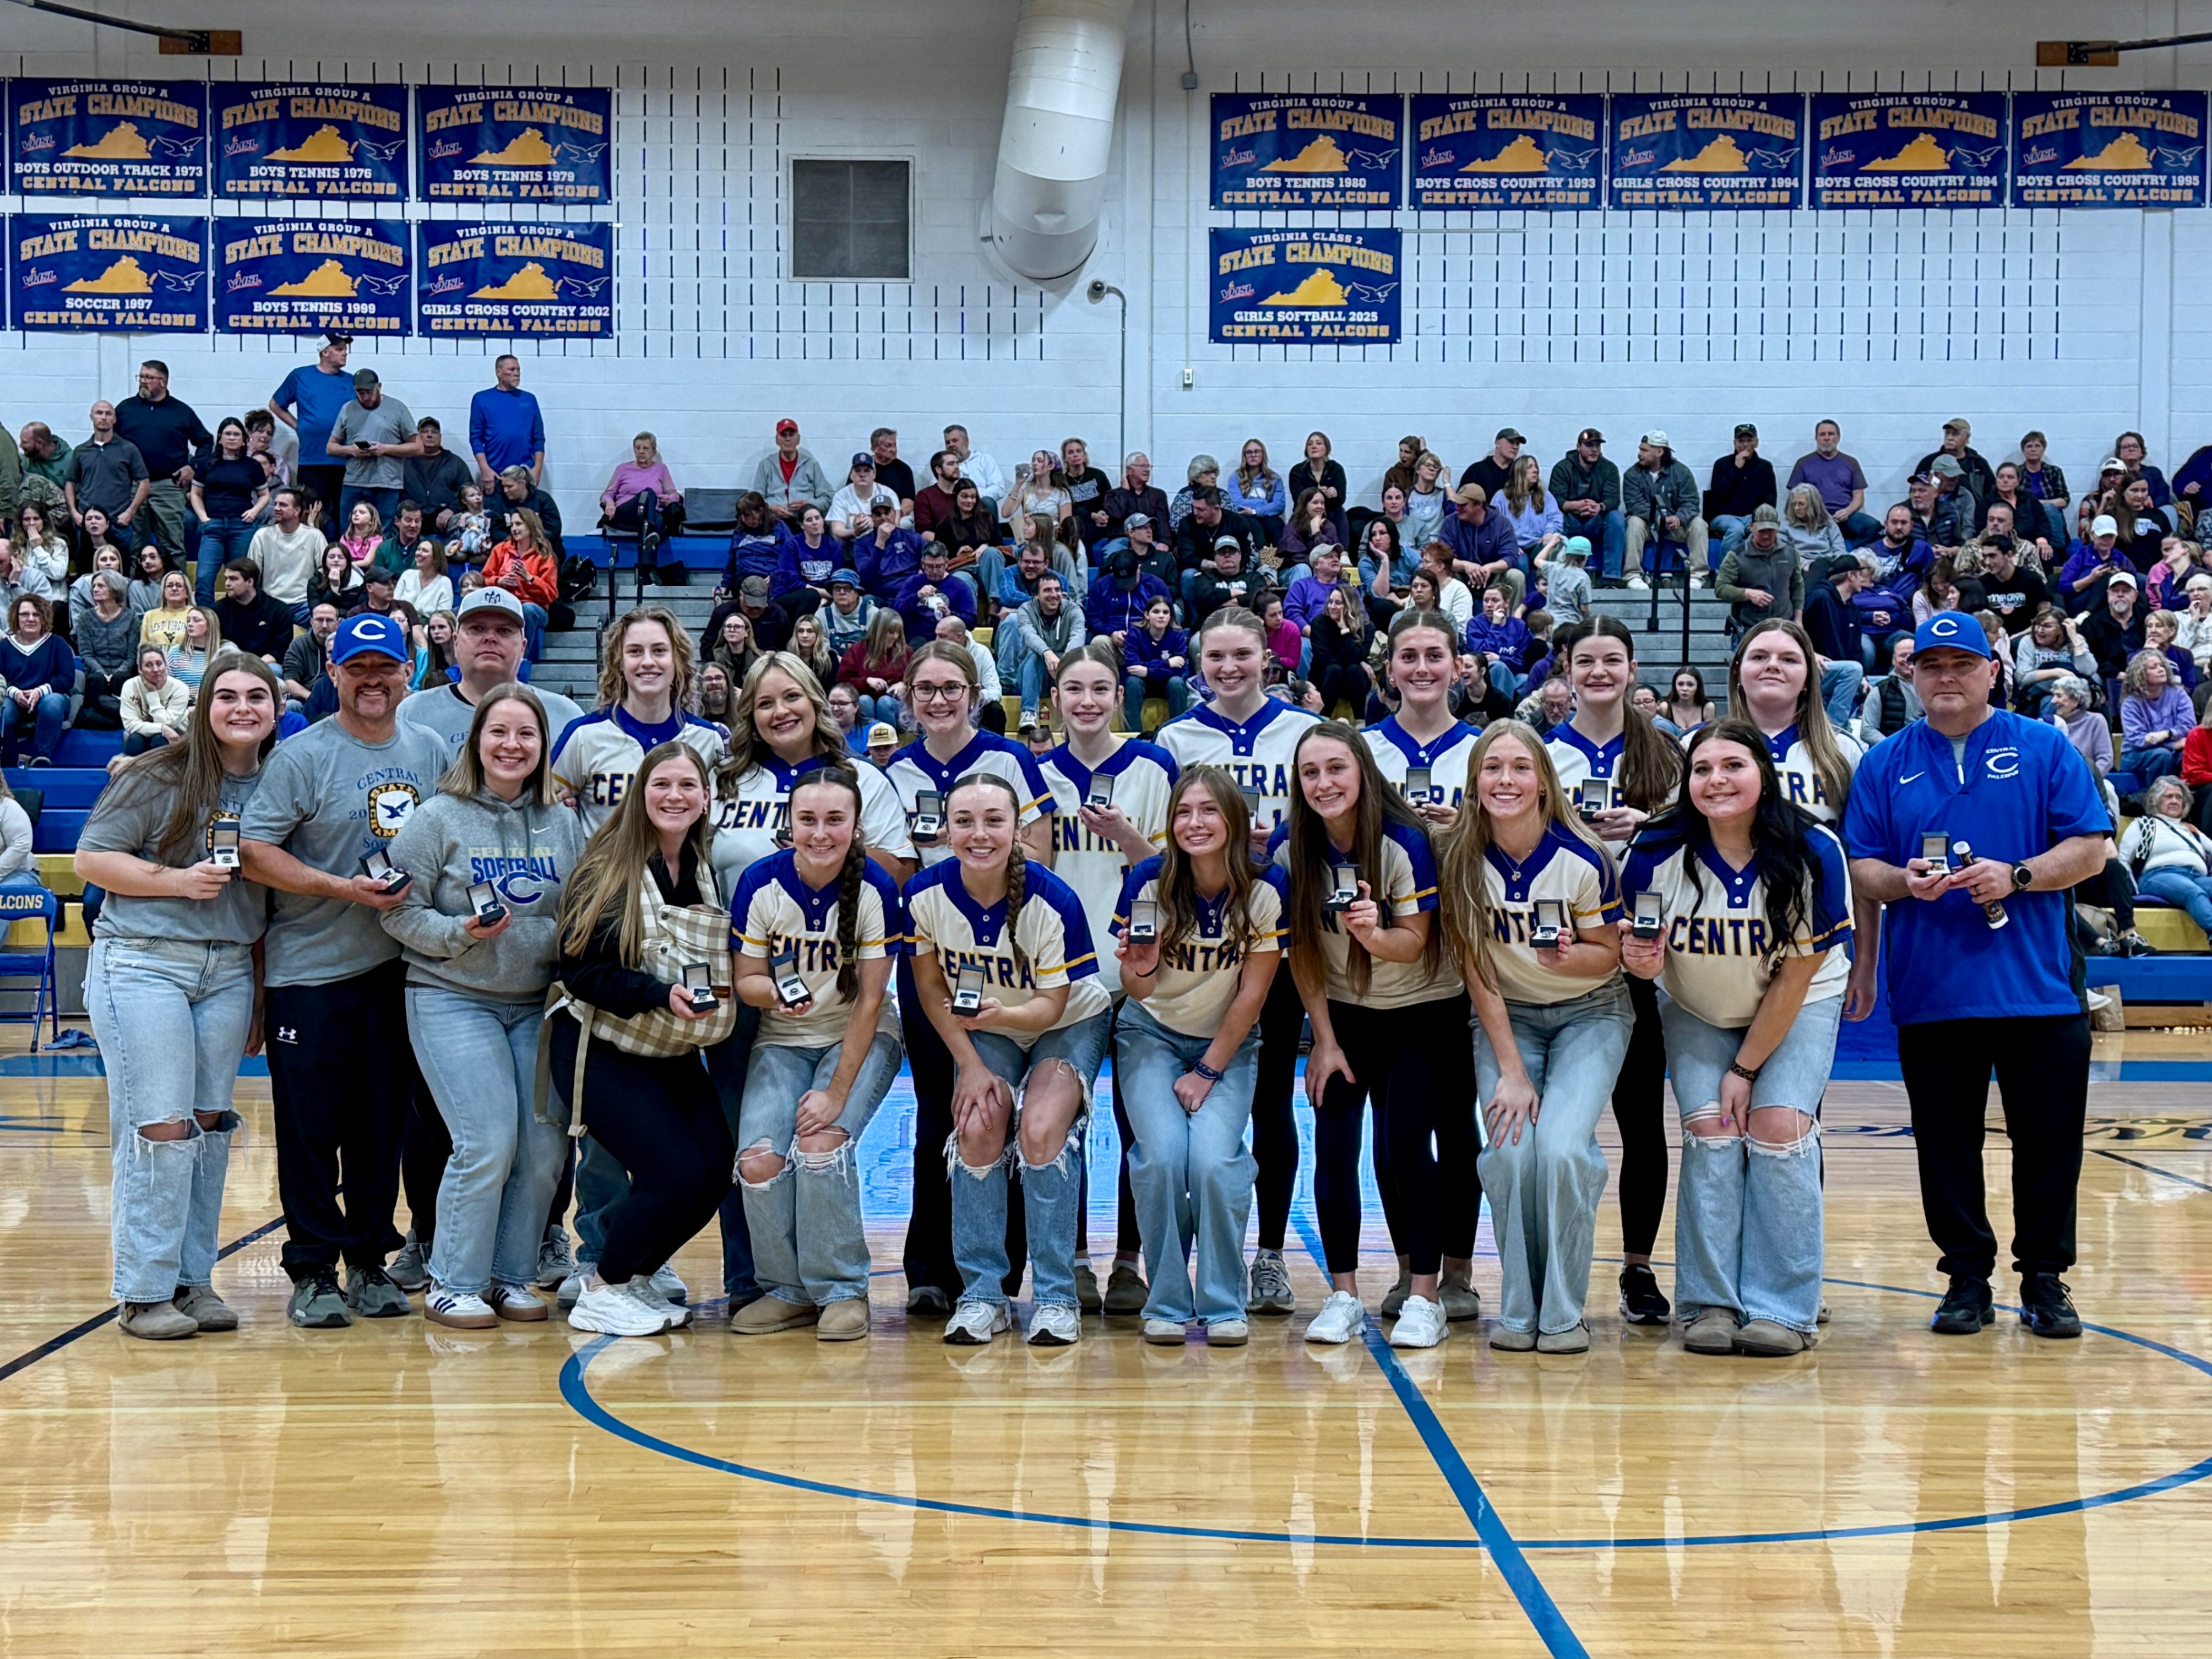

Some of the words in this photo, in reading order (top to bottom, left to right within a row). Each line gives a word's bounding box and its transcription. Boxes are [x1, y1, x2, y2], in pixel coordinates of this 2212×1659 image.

[48, 84, 107, 96] VIRGINIA
[112, 84, 155, 95] GROUP
[160, 89, 168, 98] A
[251, 88, 310, 99] VIRGINIA
[315, 88, 357, 99] GROUP
[362, 93, 370, 101] A
[455, 91, 513, 102] VIRGINIA
[519, 91, 561, 102] GROUP
[565, 96, 573, 104] A
[1250, 99, 1307, 110] VIRGINIA
[1312, 99, 1354, 109] GROUP
[1358, 102, 1366, 111] A
[1449, 99, 1507, 111] VIRGINIA
[1512, 99, 1554, 109] GROUP
[1558, 102, 1567, 111] A
[1650, 98, 1708, 110] VIRGINIA
[1713, 98, 1754, 109] GROUP
[1759, 102, 1767, 110] A
[1850, 97, 1909, 109] VIRGINIA
[1913, 97, 1955, 107] GROUP
[1959, 100, 1968, 109] A
[2052, 96, 2110, 108] VIRGINIA
[2115, 96, 2157, 107] GROUP
[2162, 100, 2170, 108] A
[19, 96, 77, 126] STATE
[88, 94, 198, 128] CHAMPIONS
[222, 99, 279, 129] STATE
[291, 98, 400, 132] CHAMPIONS
[426, 102, 483, 133] STATE
[494, 101, 603, 135] CHAMPIONS
[1620, 111, 1677, 141] STATE
[1687, 108, 1796, 140] CHAMPIONS
[1820, 110, 1877, 140] STATE
[1888, 107, 1997, 138] CHAMPIONS
[2022, 108, 2079, 139] STATE
[2090, 107, 2198, 138] CHAMPIONS
[1221, 111, 1276, 141] STATE
[1287, 109, 1395, 141] CHAMPIONS
[1420, 111, 1476, 142] STATE
[1487, 109, 1595, 140] CHAMPIONS
[14, 163, 50, 173] BOYS
[53, 164, 119, 175] OUTDOOR
[123, 165, 171, 176] TRACK
[175, 166, 203, 177] 1973
[250, 166, 285, 177] BOYS
[289, 167, 340, 178] TENNIS
[344, 168, 372, 178] 1976
[454, 170, 489, 181] BOYS
[493, 171, 543, 181] TENNIS
[547, 171, 575, 182] 1979
[23, 177, 106, 190] CENTRAL
[113, 178, 195, 192] FALCONS
[1246, 177, 1281, 188] BOYS
[1285, 177, 1334, 188] TENNIS
[1339, 178, 1366, 188] 1980
[1416, 178, 1450, 188] BOYS
[1454, 178, 1497, 188] CROSS
[1501, 178, 1564, 188] COUNTRY
[1568, 178, 1596, 188] 1993
[1613, 177, 1653, 188] GIRLS
[1656, 177, 1700, 188] CROSS
[1703, 177, 1767, 188] COUNTRY
[1771, 177, 1798, 188] 1994
[1815, 177, 1851, 188] BOYS
[1854, 177, 1898, 187] CROSS
[1901, 176, 1966, 187] COUNTRY
[1970, 176, 1998, 186] 1994
[2017, 176, 2053, 186] BOYS
[2056, 175, 2100, 186] CROSS
[2104, 175, 2167, 186] COUNTRY
[2171, 175, 2199, 186] 1995
[226, 181, 309, 193] CENTRAL
[317, 182, 396, 194] FALCONS
[430, 184, 513, 197] CENTRAL
[520, 185, 599, 197] FALCONS
[1222, 192, 1305, 203] CENTRAL
[1311, 192, 1390, 203] FALCONS
[1422, 192, 1504, 203] CENTRAL
[1511, 192, 1589, 203] FALCONS
[1621, 192, 1704, 203] CENTRAL
[1710, 191, 1790, 203] FALCONS
[1822, 191, 1905, 203] CENTRAL
[1911, 189, 1991, 202] FALCONS
[2023, 189, 2107, 202] CENTRAL
[2114, 189, 2193, 201] FALCONS
[49, 219, 109, 231] VIRGINIA
[114, 219, 157, 230] GROUP
[162, 224, 170, 232] A
[254, 223, 314, 235] VIRGINIA
[318, 222, 361, 233] GROUP
[365, 228, 373, 236] A
[456, 226, 515, 238] VIRGINIA
[520, 226, 562, 237] GROUP
[566, 230, 574, 238] A
[1251, 232, 1308, 244] VIRGINIA
[1313, 232, 1352, 243] CLASS
[21, 230, 78, 261] STATE
[89, 229, 199, 263] CHAMPIONS
[225, 234, 282, 265] STATE
[294, 233, 403, 266] CHAMPIONS
[428, 238, 484, 268] STATE
[495, 236, 604, 269] CHAMPIONS
[1219, 244, 1275, 275] STATE
[1286, 243, 1393, 274] CHAMPIONS
[66, 298, 120, 309] SOCCER
[124, 300, 153, 309] 1997
[253, 302, 289, 313] BOYS
[292, 302, 343, 313] TENNIS
[347, 303, 376, 313] 1999
[422, 304, 461, 315] GIRLS
[465, 304, 508, 315] CROSS
[512, 306, 576, 316] COUNTRY
[580, 306, 609, 316] 2002
[24, 312, 108, 324] CENTRAL
[115, 313, 196, 326] FALCONS
[229, 315, 312, 328] CENTRAL
[319, 316, 400, 329] FALCONS
[1234, 311, 1274, 322] GIRLS
[1277, 311, 1346, 322] SOFTBALL
[1349, 311, 1378, 322] 2025
[431, 318, 514, 330] CENTRAL
[521, 319, 601, 331] FALCONS
[1222, 325, 1304, 336] CENTRAL
[1311, 325, 1389, 337] FALCONS
[351, 619, 386, 640] C
[1931, 618, 1958, 636] C
[1986, 752, 2019, 773] C
[357, 768, 422, 790] CENTRAL
[371, 784, 416, 798] STATE
[719, 801, 787, 829] CENT
[0, 895, 44, 910] LCONS
[1669, 916, 1767, 956] CENTR
